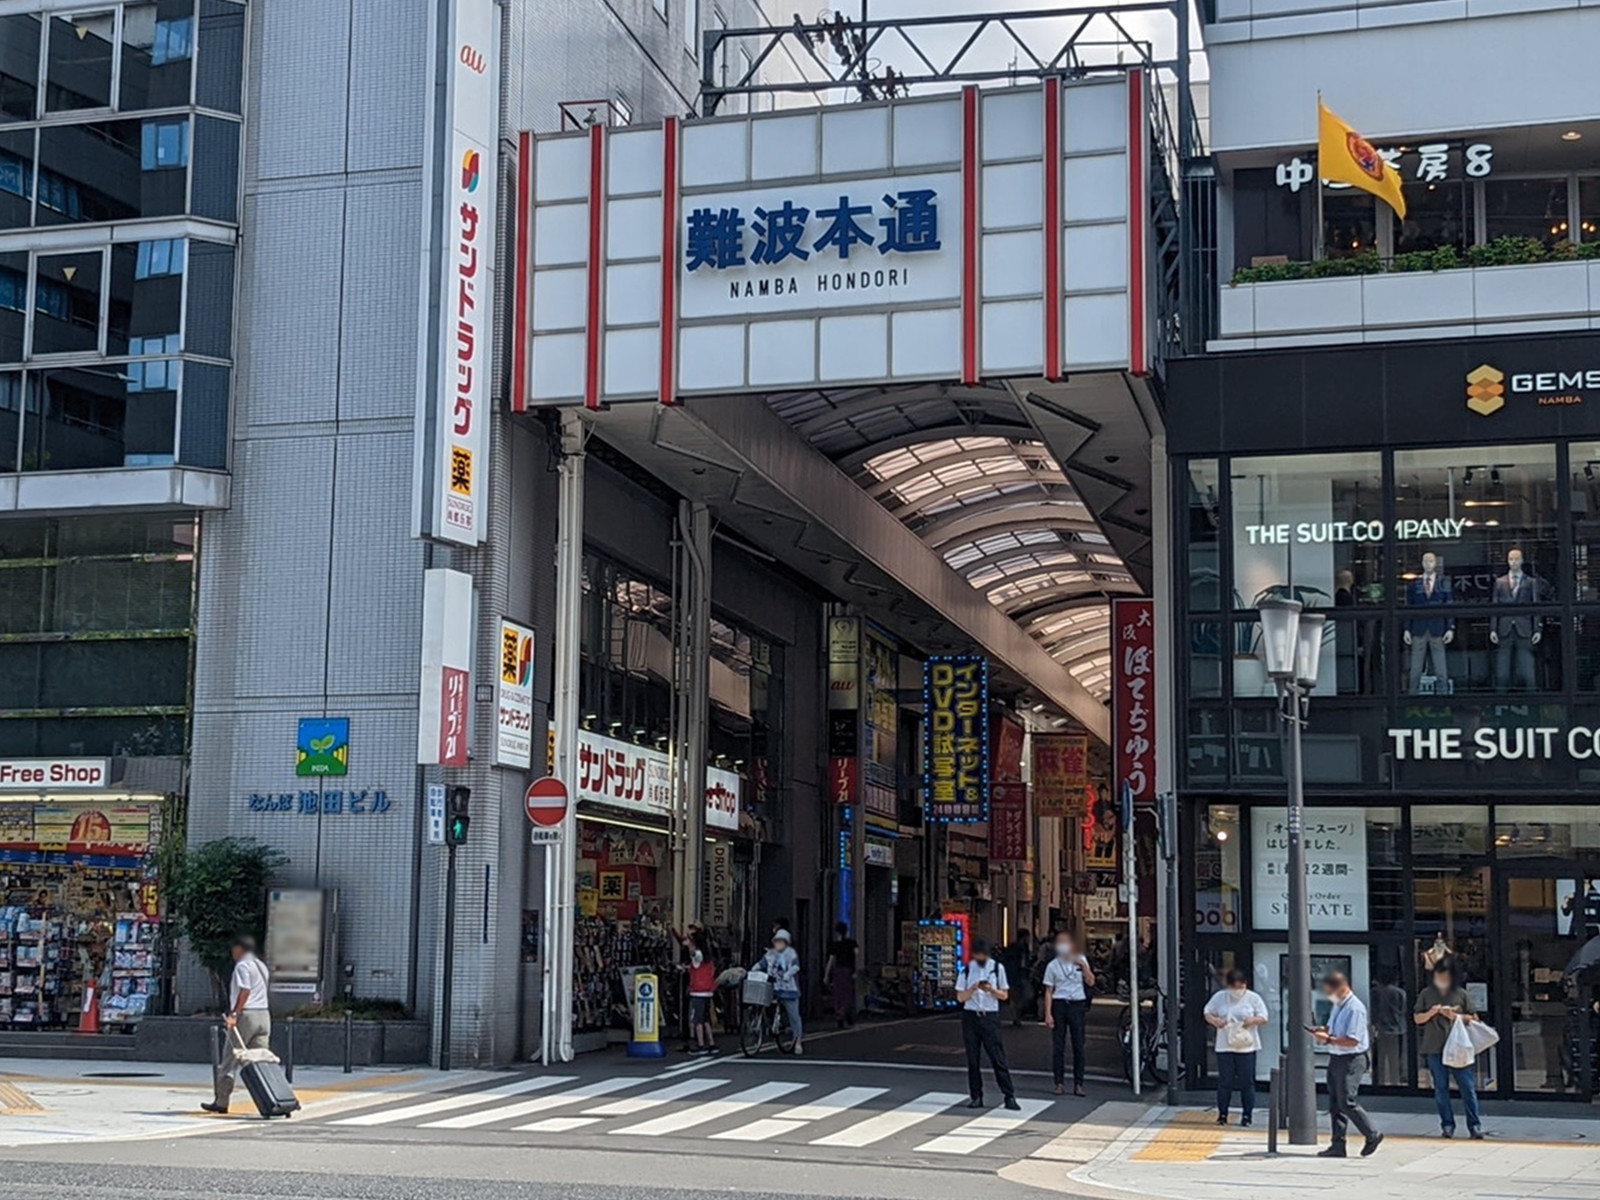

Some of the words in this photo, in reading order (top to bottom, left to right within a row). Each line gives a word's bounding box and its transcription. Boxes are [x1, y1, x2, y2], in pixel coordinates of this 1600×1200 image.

[460, 44, 486, 75] au
[686, 189, 942, 272] 難波本通
[730, 277, 798, 298] NAMBA
[817, 268, 908, 292] HONDORI
[454, 202, 479, 436] サンドラッグ
[1511, 370, 1600, 393] GEMS
[1538, 395, 1582, 405] NAMBA
[452, 449, 470, 492] 薬
[1245, 524, 1290, 545] THE
[1297, 522, 1348, 543] SUIT
[502, 632, 518, 681] 薬
[830, 680, 856, 690] au
[445, 675, 458, 760] リーブ21
[932, 665, 957, 801] DVD試写室
[1388, 728, 1462, 760] THE
[1474, 726, 1559, 760] SUIT
[1567, 726, 1600, 760] C
[0, 765, 45, 783] Free
[50, 764, 102, 783] Shop
[579, 743, 646, 802] サンドラッグ
[249, 794, 293, 812] なんば
[297, 789, 391, 815] 池田ビル
[1266, 838, 1341, 851] はじました。
[714, 847, 725, 882] DRUG
[602, 874, 622, 896] 薬
[714, 884, 725, 894] &
[713, 897, 725, 923] LIFE
